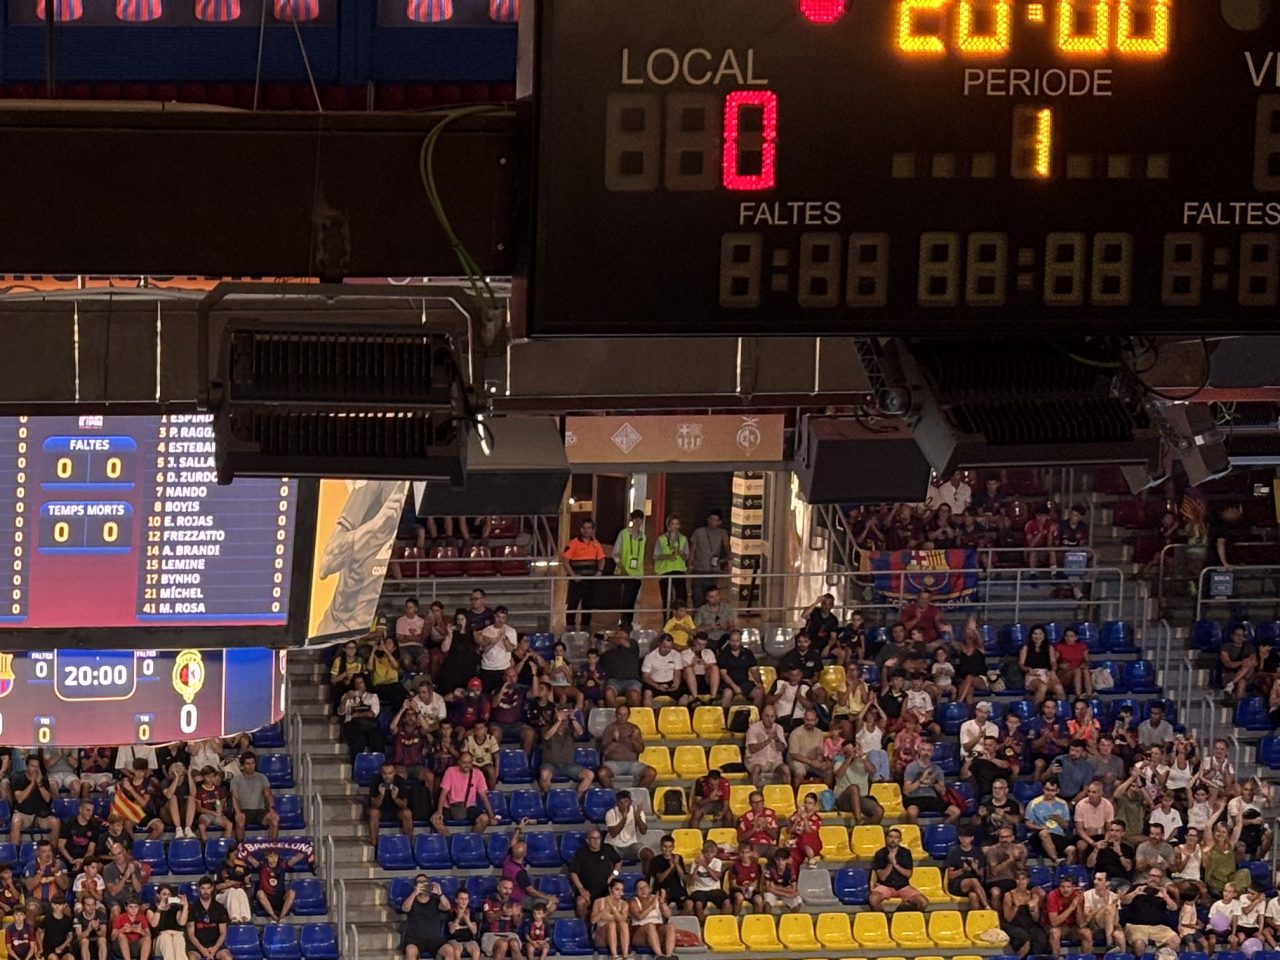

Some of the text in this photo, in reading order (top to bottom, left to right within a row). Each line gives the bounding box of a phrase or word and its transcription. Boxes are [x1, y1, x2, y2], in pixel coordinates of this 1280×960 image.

[621, 48, 769, 85] LOCAL
[963, 69, 1113, 96] PERIODE
[723, 90, 778, 190] 0
[1035, 108, 1052, 177] 1
[739, 202, 842, 226] FALTES
[1183, 202, 1280, 226] FALTES
[19, 427, 27, 438] 0
[159, 427, 215, 438] 3 P. RAGG
[18, 442, 26, 453] 0
[70, 439, 110, 450] FALTES
[158, 442, 216, 453] 4 ESTEBA
[18, 458, 26, 468] 0
[56, 458, 122, 478] 0 0
[157, 457, 164, 468] 5
[168, 457, 177, 468] J.
[17, 472, 26, 483] 0
[156, 472, 164, 482] 6
[167, 472, 179, 482] D.
[16, 488, 24, 498] 0
[156, 487, 289, 498] 7 NANDO 0
[16, 502, 24, 513] 0
[48, 505, 124, 516] TEMPS MORTS
[154, 502, 288, 512] 8 BOYIS 0
[16, 517, 24, 528] 0
[148, 516, 286, 526] 10 E. ROJAS 0
[15, 532, 22, 542] 0
[54, 522, 118, 542] 0 0
[148, 531, 286, 541] 12 FREZZATTO 0
[14, 546, 22, 557] 0
[146, 545, 284, 556] 14 A. BRANDI 0
[14, 560, 22, 571] 0
[146, 560, 282, 570] 15 LEMINE 0
[13, 575, 21, 586] 0
[146, 574, 282, 584] 17 BYNHO 0
[12, 590, 20, 600] 0
[144, 585, 280, 598] 21 MÍCHEL 0
[12, 604, 20, 614] 0
[143, 602, 280, 613] 41 M. ROSA 0
[36, 661, 48, 678] 0
[142, 659, 154, 676] 0
[64, 665, 127, 686] 20:00
[180, 704, 198, 734] 0
[38, 727, 50, 744] 0
[138, 724, 150, 740] 0
